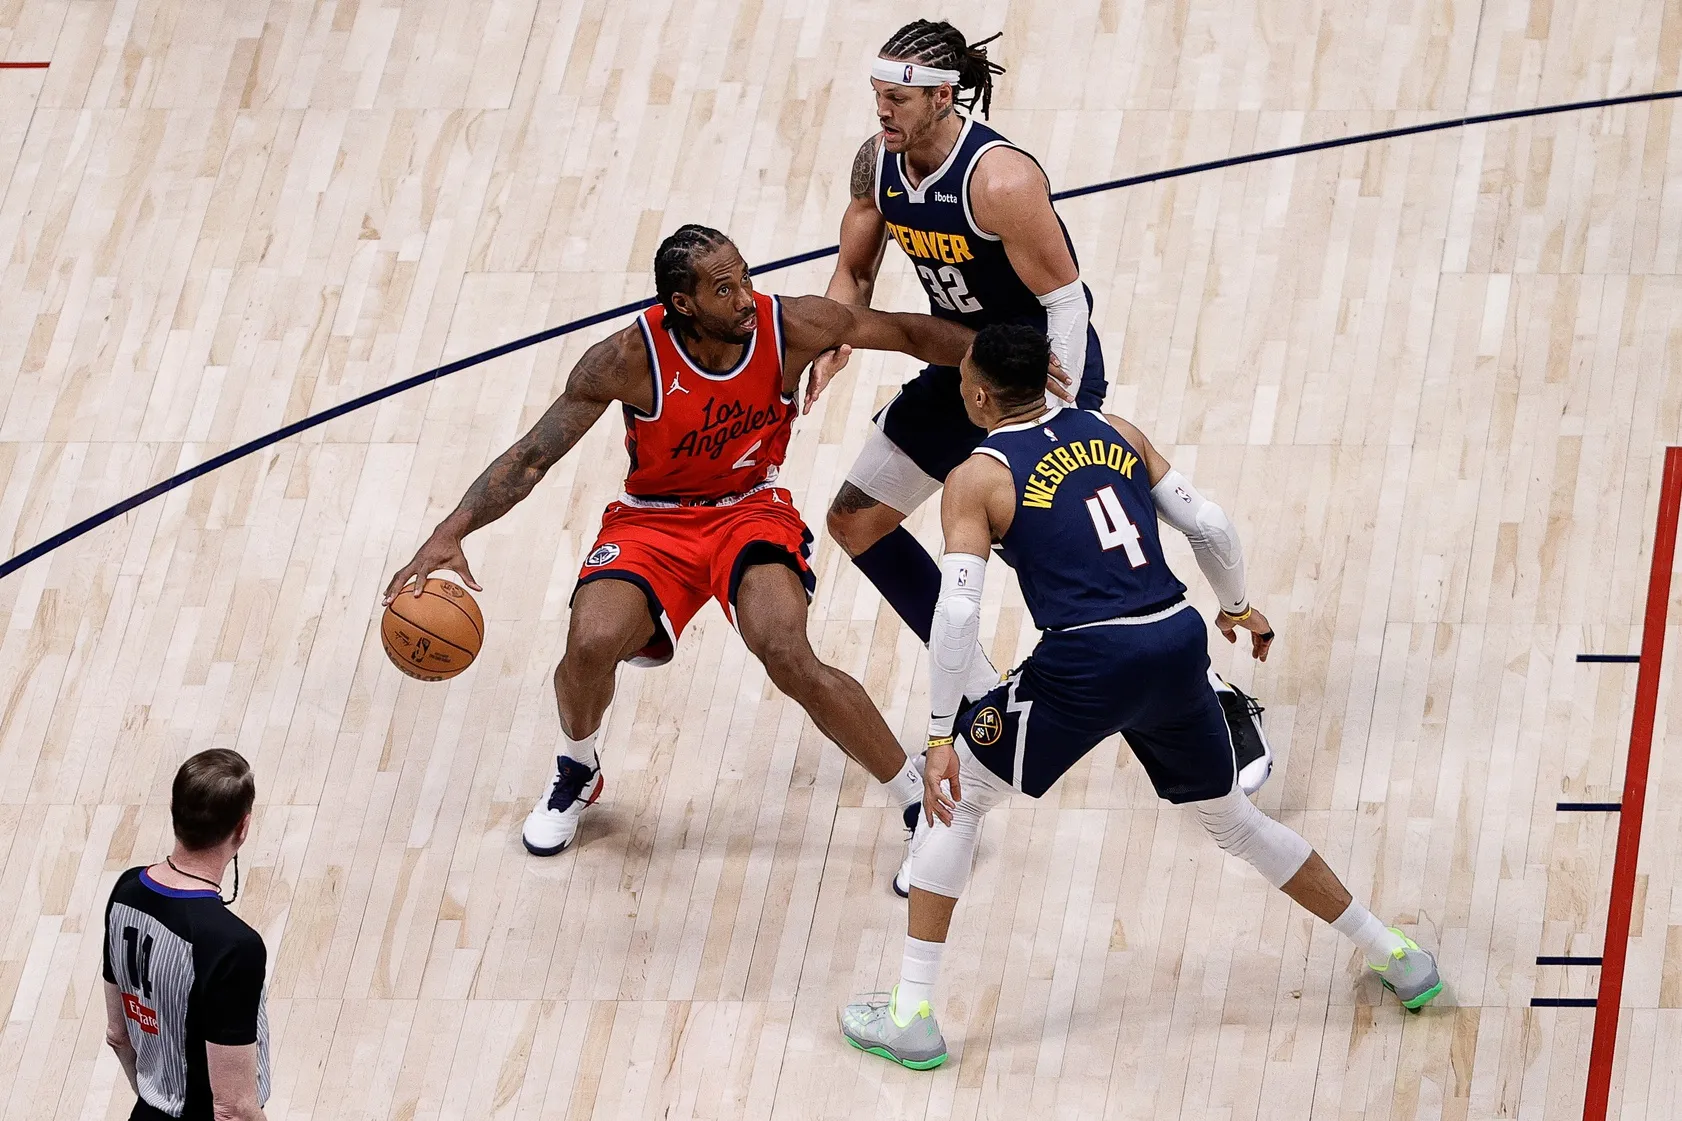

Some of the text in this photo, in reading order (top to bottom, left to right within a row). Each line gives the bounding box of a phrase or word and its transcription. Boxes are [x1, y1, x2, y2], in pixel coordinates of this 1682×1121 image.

[934, 191, 958, 204] ibotta
[917, 265, 984, 314] 32
[670, 404, 780, 460] Angeles
[701, 396, 746, 432] Los
[1022, 439, 1138, 509] WESTBROOK
[1083, 483, 1149, 570] 4
[123, 926, 154, 1000] 11
